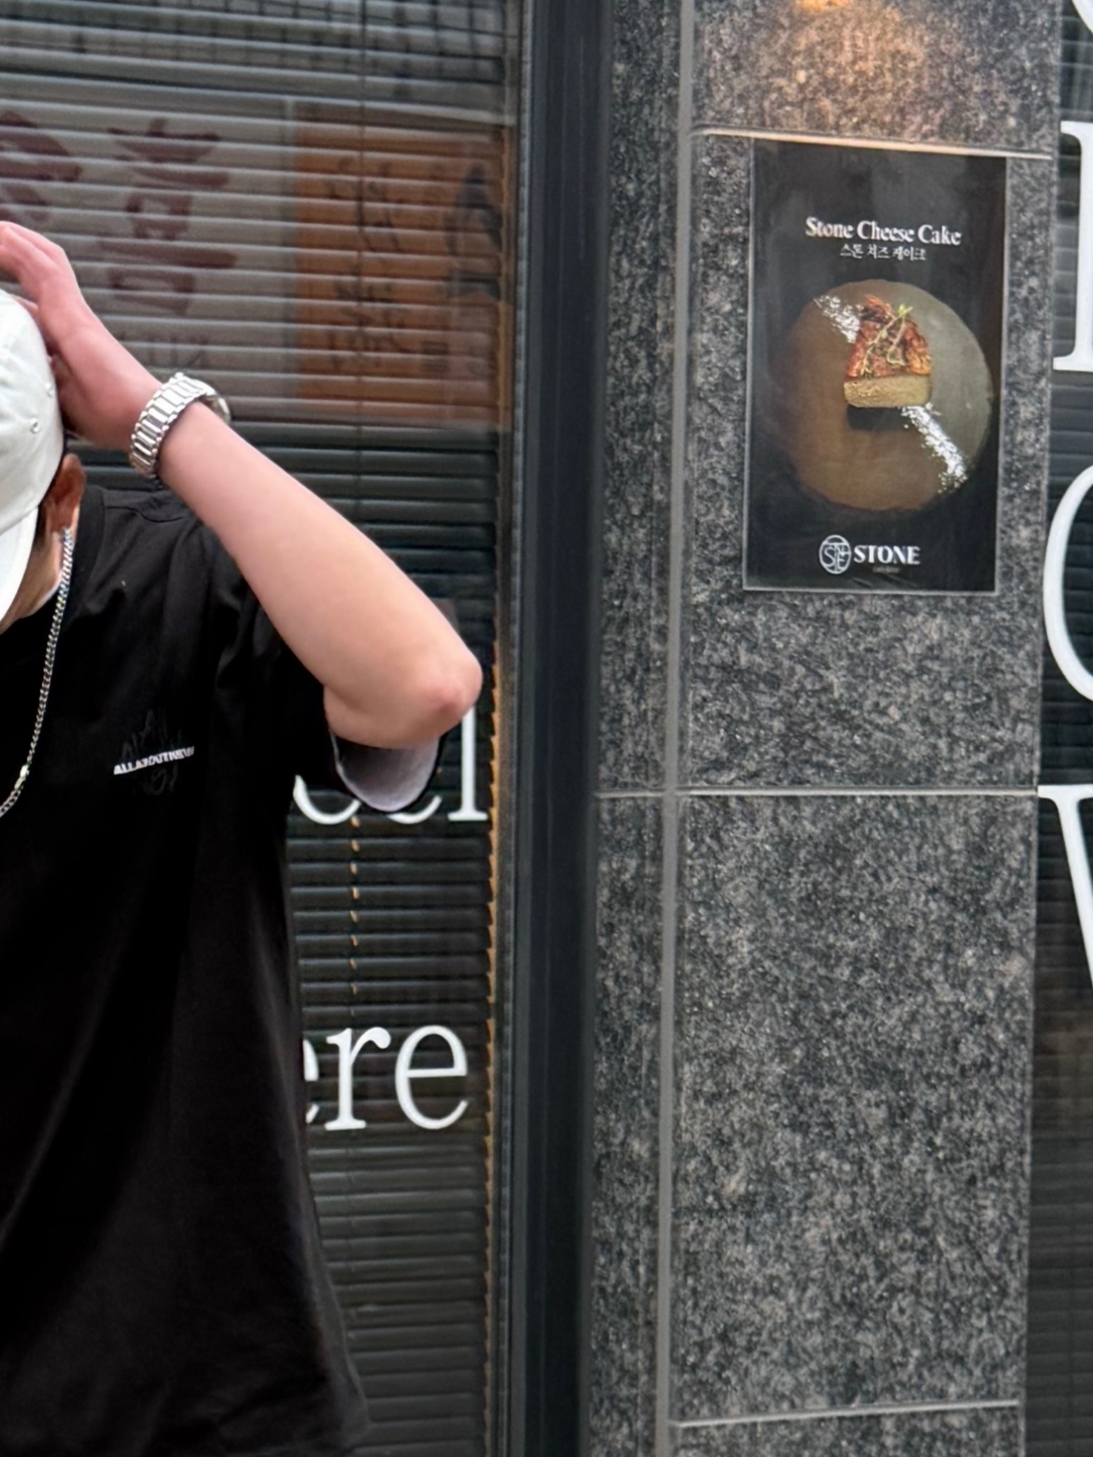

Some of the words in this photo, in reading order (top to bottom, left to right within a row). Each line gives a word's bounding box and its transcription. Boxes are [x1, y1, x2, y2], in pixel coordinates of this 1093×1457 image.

[806, 216, 854, 239] Stone
[857, 220, 915, 242] Cheese
[918, 224, 962, 246] Cake
[853, 544, 921, 565] STONE
